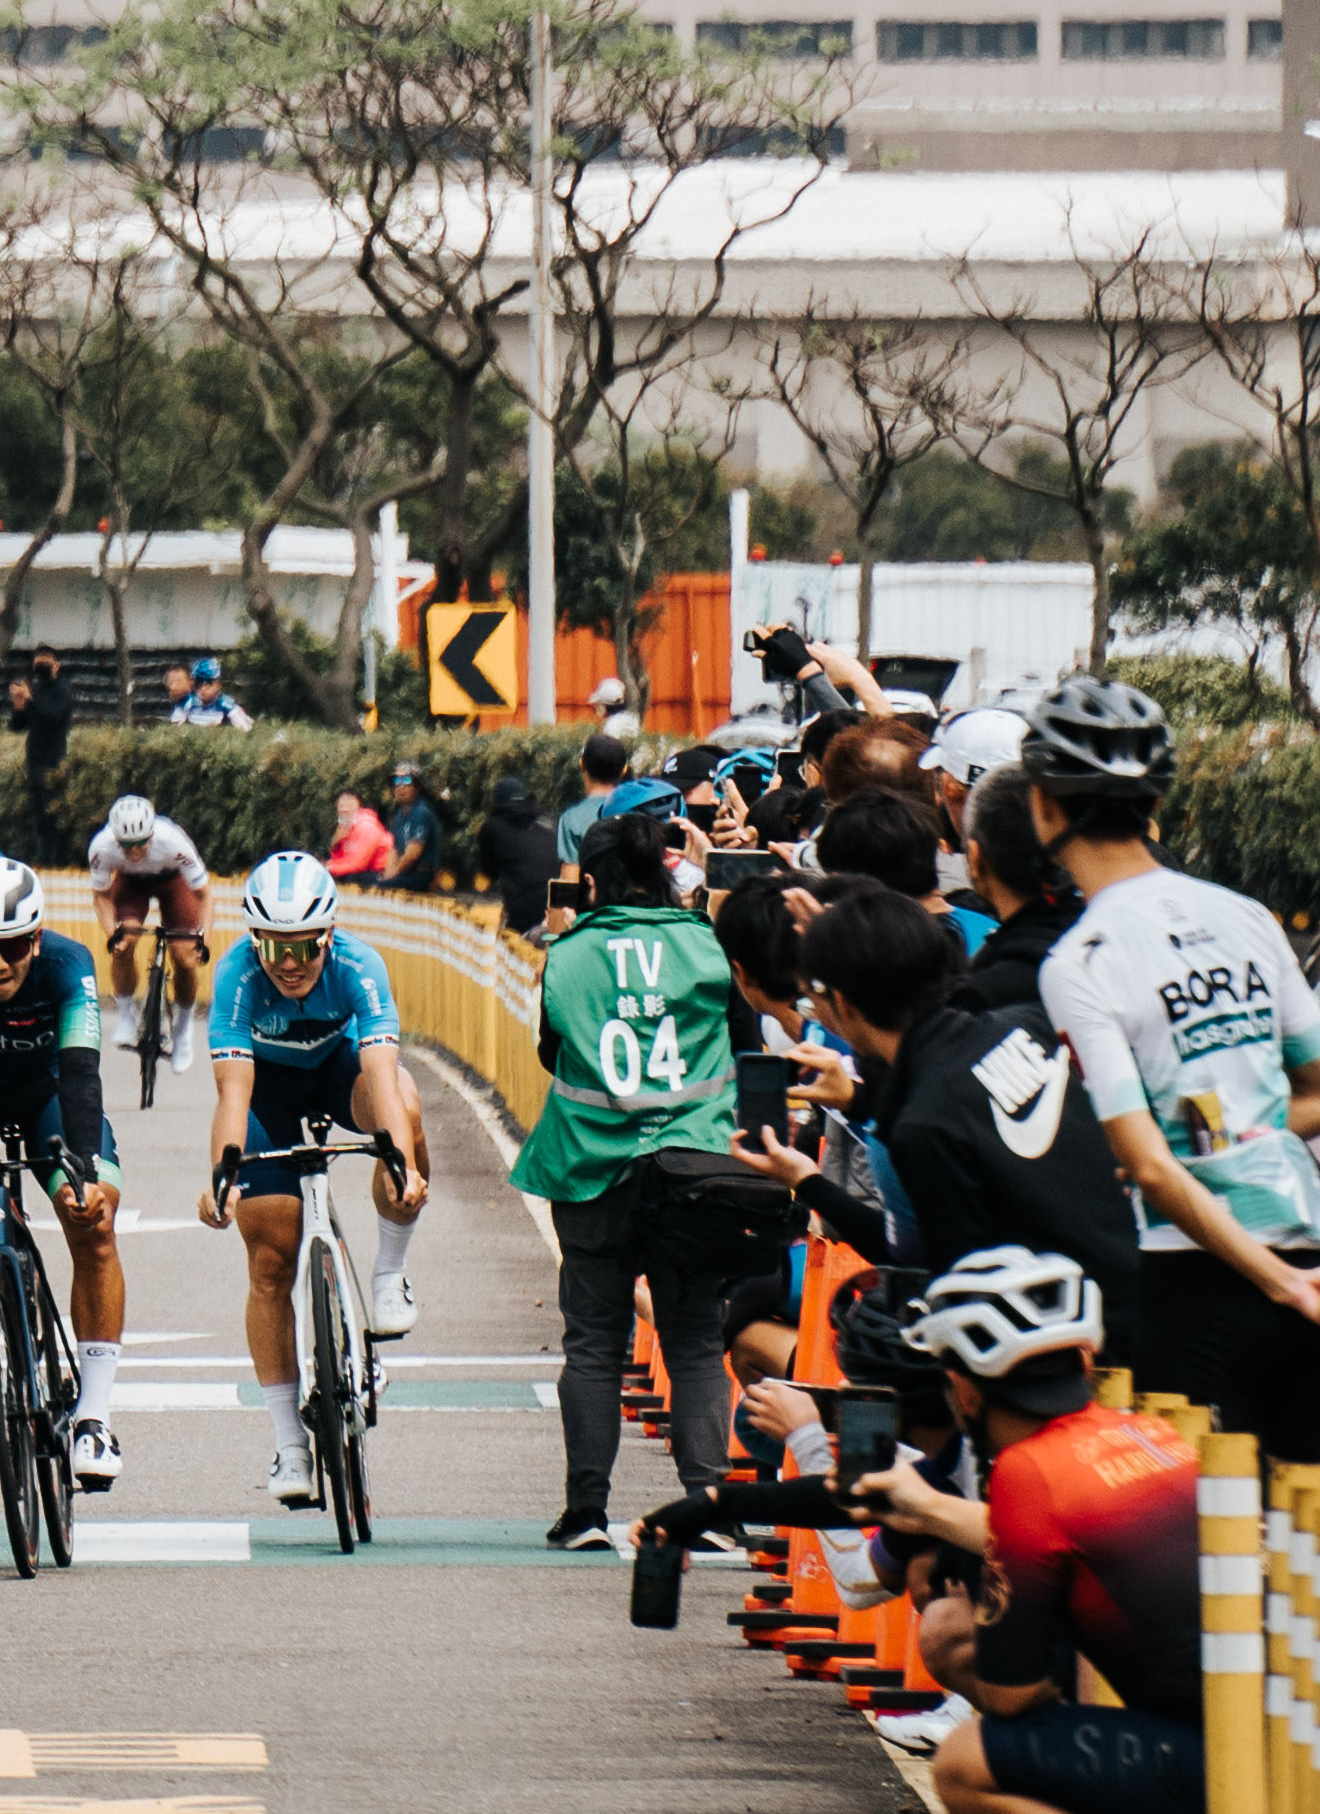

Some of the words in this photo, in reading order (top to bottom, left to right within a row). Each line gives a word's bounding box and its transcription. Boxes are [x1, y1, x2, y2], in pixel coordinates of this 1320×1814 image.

[607, 938, 662, 988] TV
[1157, 961, 1270, 1023] BORA
[599, 1015, 687, 1097] 04
[970, 1027, 1057, 1114] NIKE
